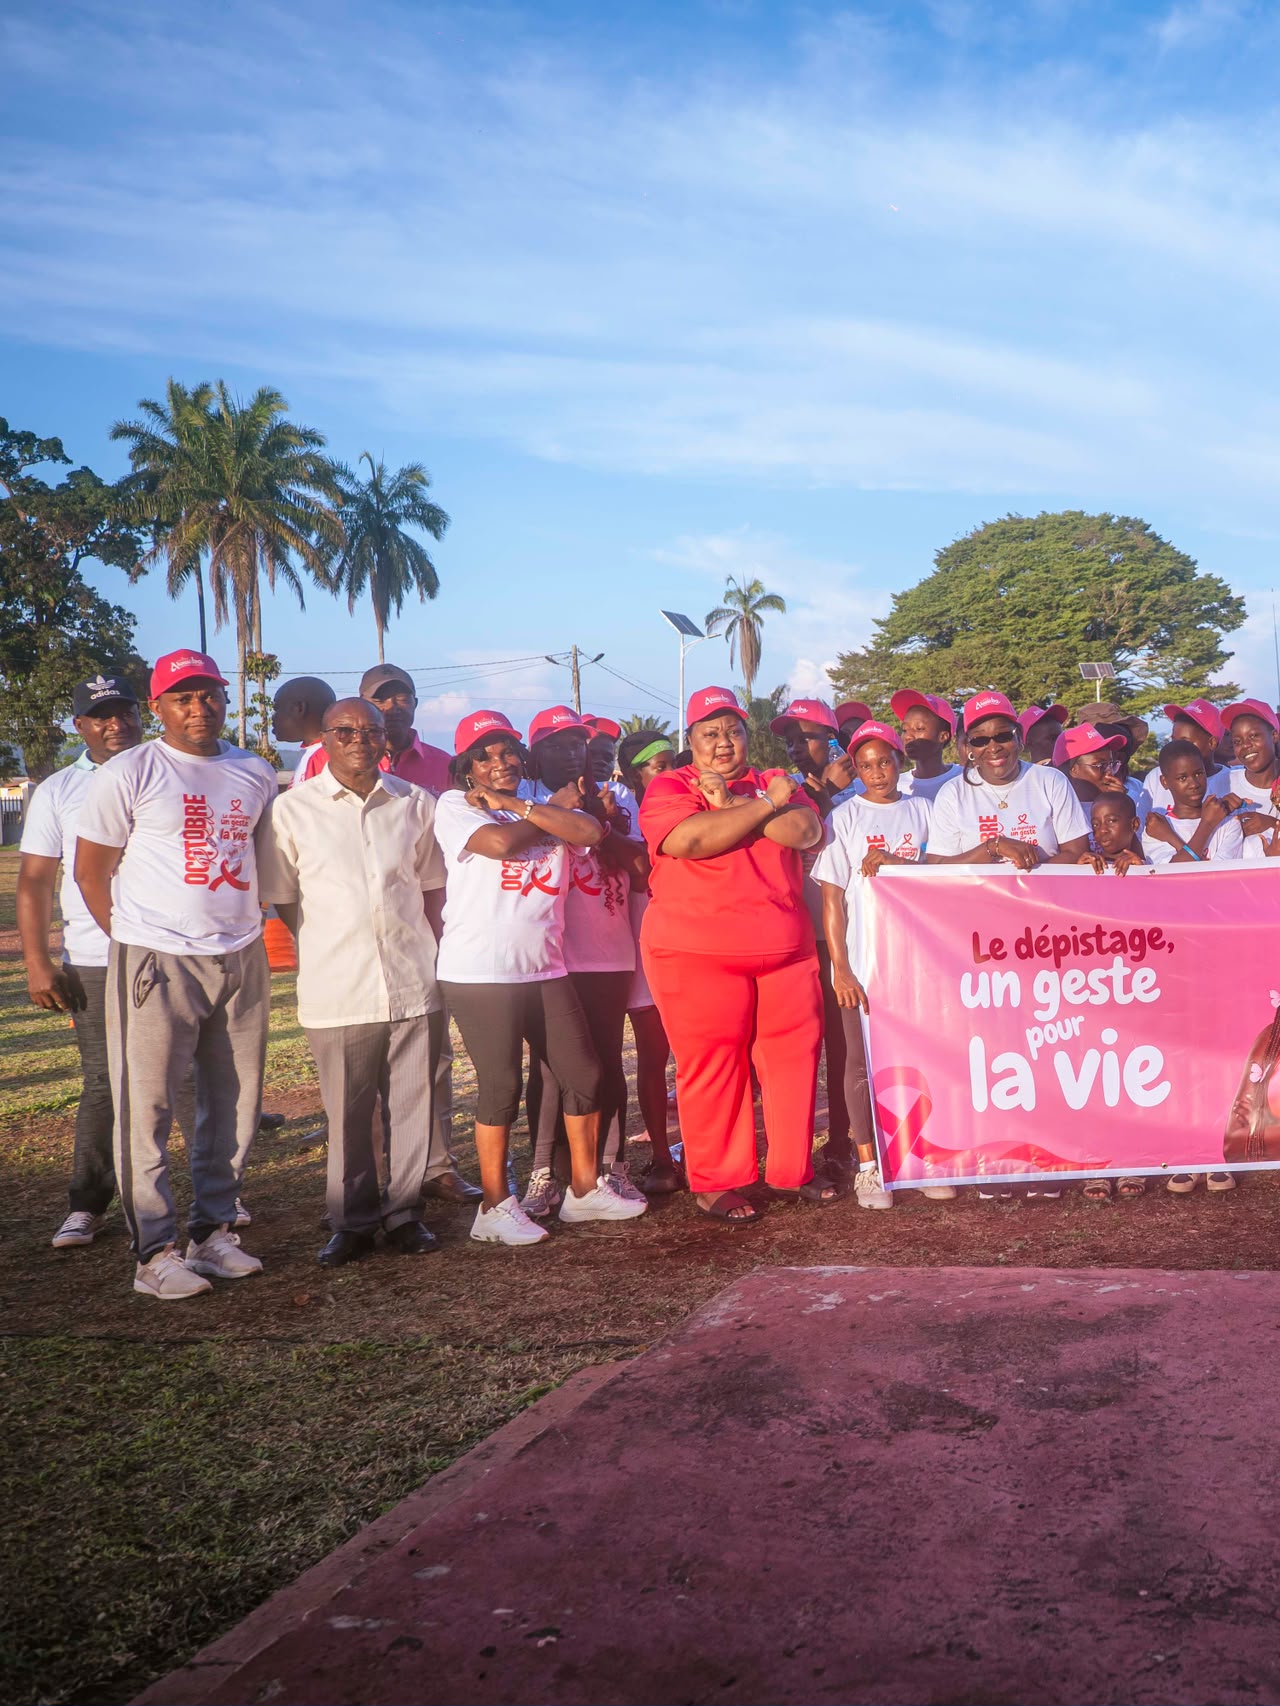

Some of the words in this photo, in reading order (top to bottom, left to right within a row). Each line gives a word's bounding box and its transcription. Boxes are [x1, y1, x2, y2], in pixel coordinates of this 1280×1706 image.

[90, 689, 121, 700] adidas
[220, 828, 230, 840] la
[232, 829, 248, 841] vie
[973, 931, 1007, 963] Le
[1014, 923, 1175, 968] dépistage,
[960, 969, 1021, 1009] un
[1033, 956, 1161, 1022] geste
[1026, 1014, 1085, 1060] pour
[968, 1035, 1036, 1113] la
[1053, 1028, 1172, 1111] vie
